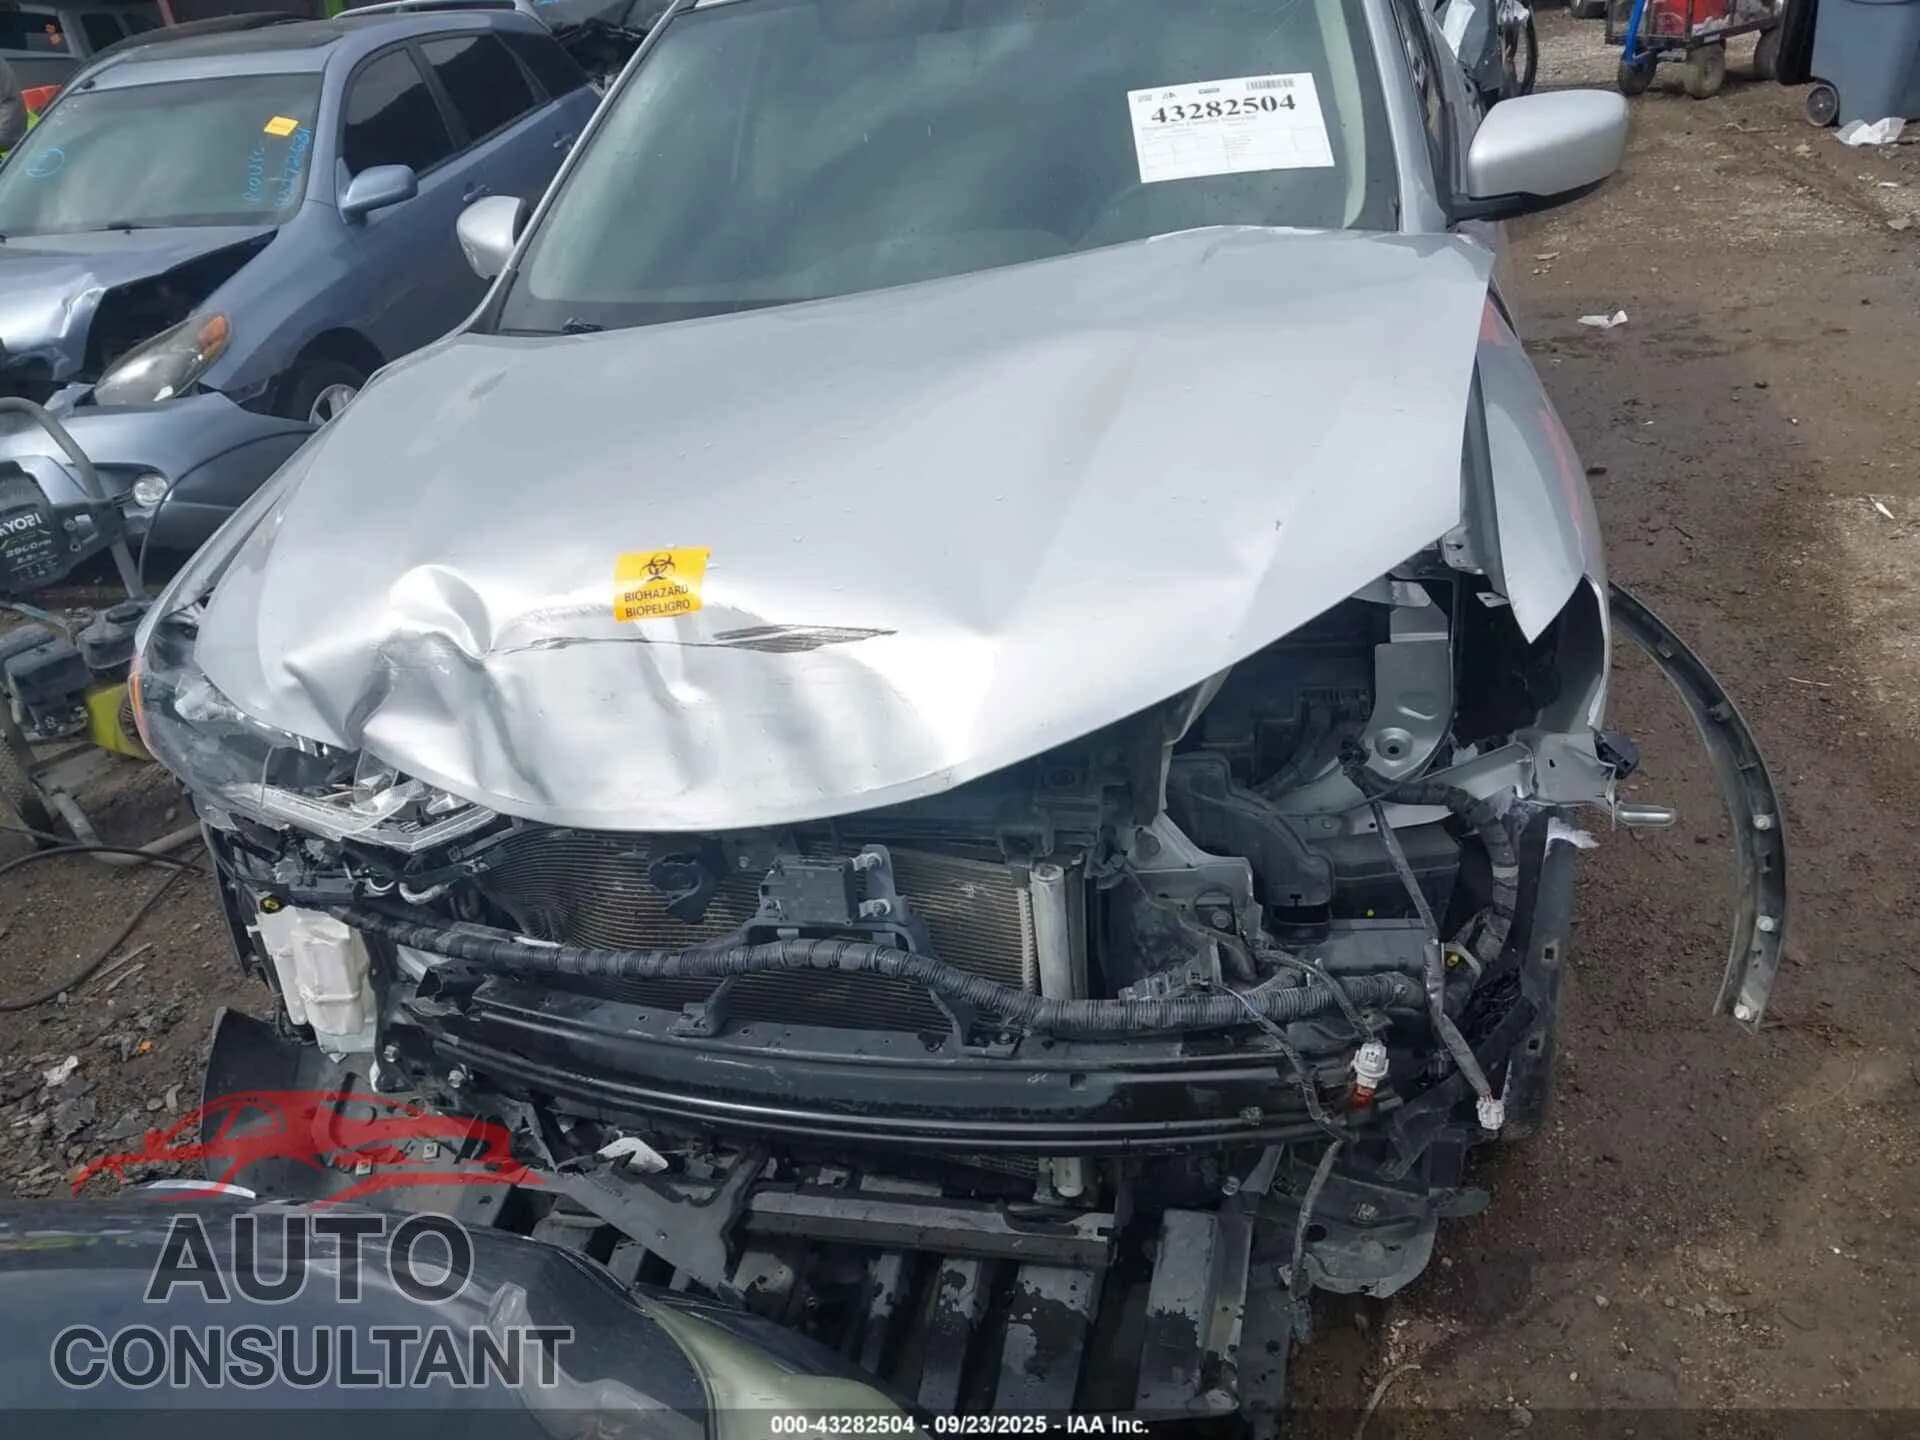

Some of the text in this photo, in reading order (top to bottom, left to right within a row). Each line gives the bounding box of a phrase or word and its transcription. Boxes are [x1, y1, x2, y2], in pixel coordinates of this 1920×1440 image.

[1151, 94, 1296, 123] 43282504
[624, 583, 688, 603] BIOHAZARD
[625, 598, 690, 617] BIOPELIGRO
